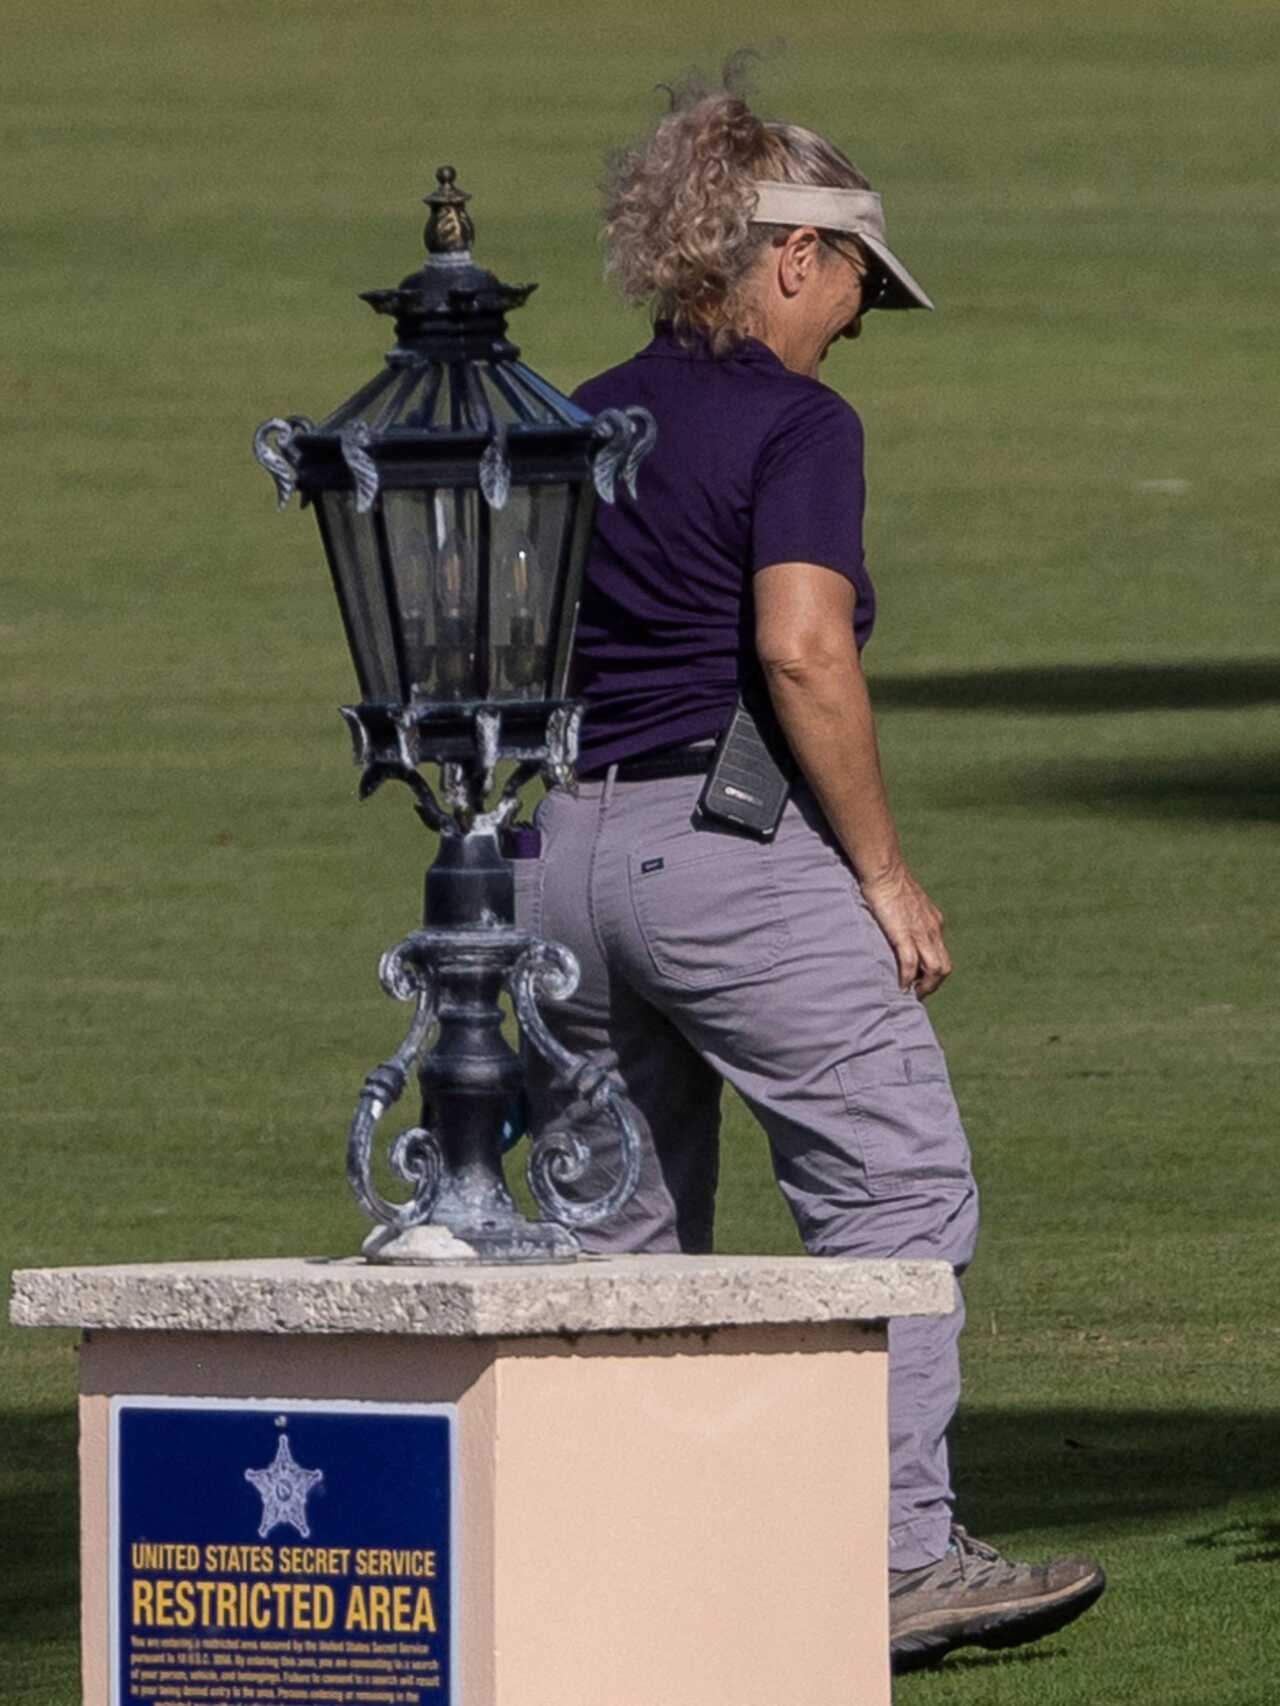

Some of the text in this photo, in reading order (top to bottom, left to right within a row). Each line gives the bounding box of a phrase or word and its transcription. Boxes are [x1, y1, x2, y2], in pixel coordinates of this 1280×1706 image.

[131, 1542, 437, 1578] UNITED STATES SECRET SERVICE
[132, 1580, 438, 1633] RESTRICTED AREA
